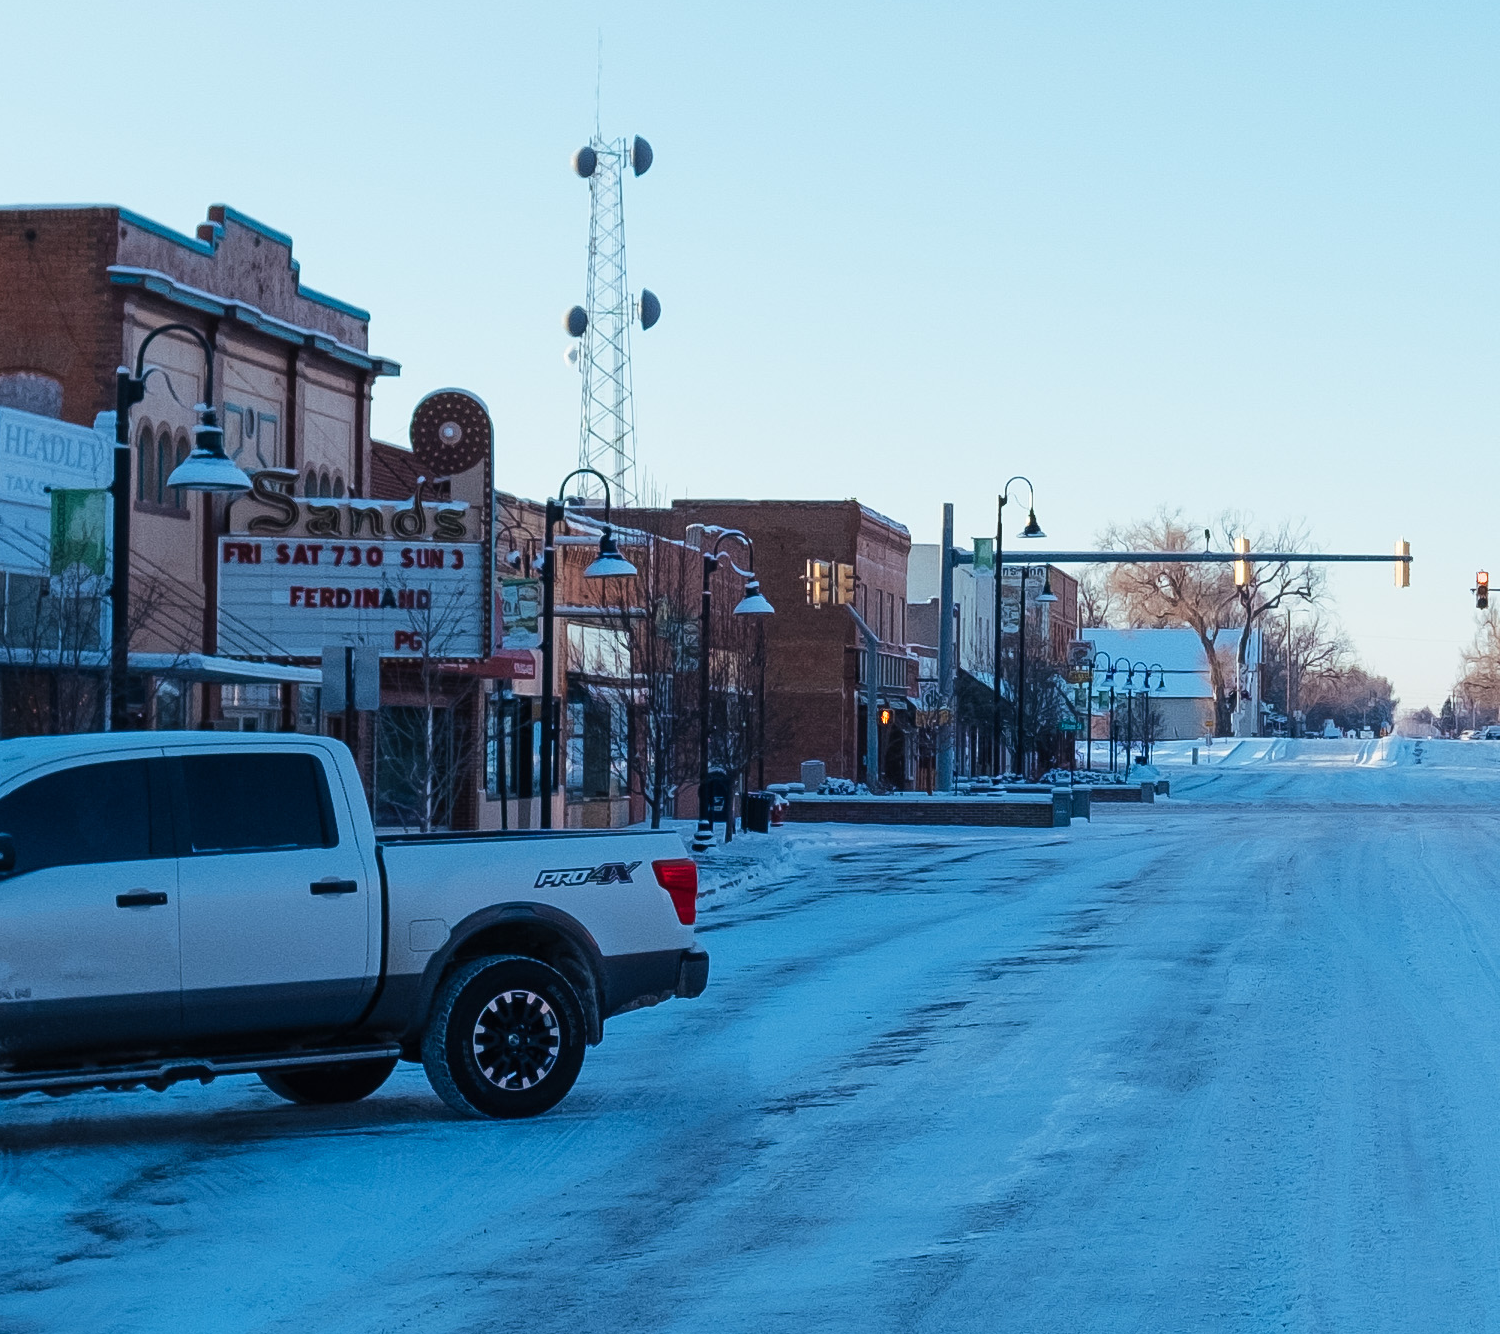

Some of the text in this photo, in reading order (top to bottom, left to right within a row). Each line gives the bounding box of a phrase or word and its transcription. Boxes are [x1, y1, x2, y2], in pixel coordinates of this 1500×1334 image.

[4, 423, 105, 472] HEADLEY
[4, 475, 34, 493] TAX
[248, 469, 467, 540] Sands
[223, 542, 464, 570] FRI SAT 730 SUN 3
[289, 585, 432, 610] FERDINAND
[394, 630, 422, 651] PG
